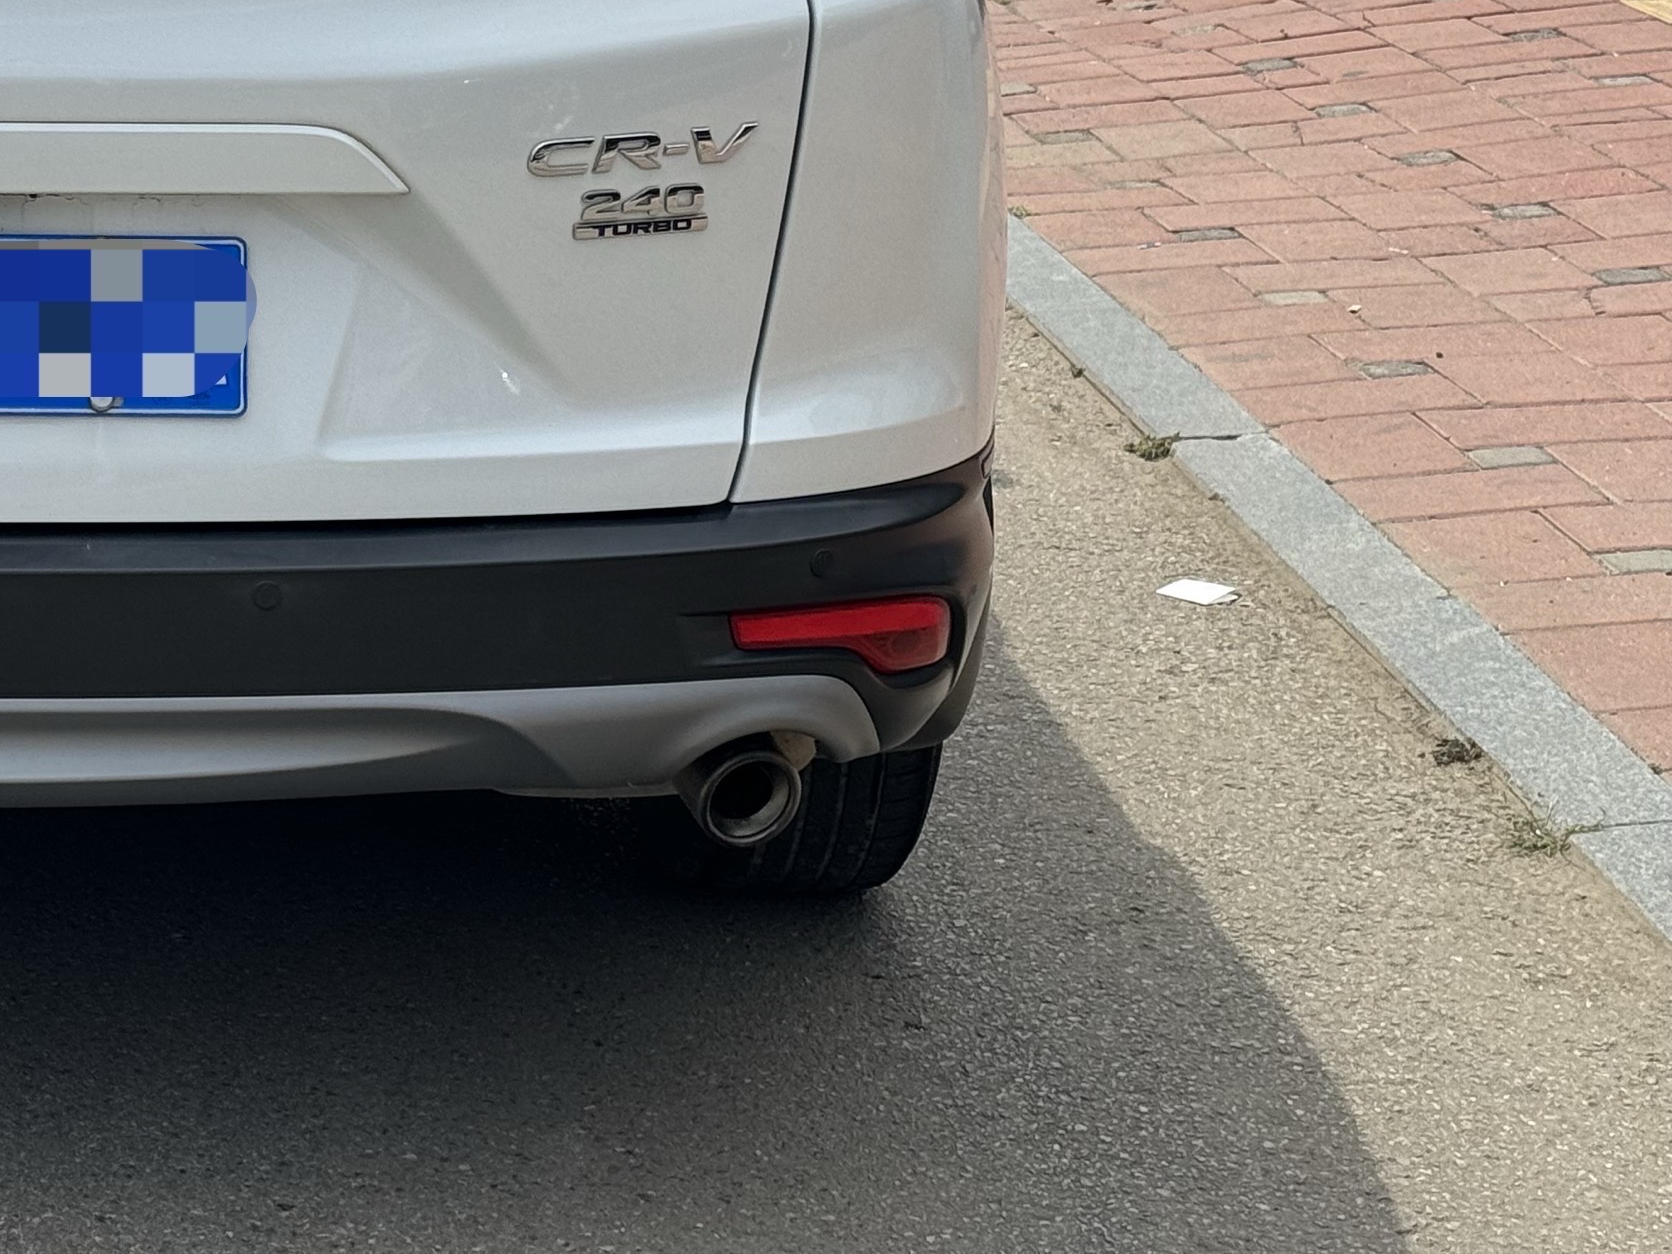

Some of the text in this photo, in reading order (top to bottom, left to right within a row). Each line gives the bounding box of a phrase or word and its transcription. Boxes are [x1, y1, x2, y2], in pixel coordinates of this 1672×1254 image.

[528, 121, 760, 177] CR-V
[581, 182, 705, 221] 240
[592, 219, 693, 237] TURBO
